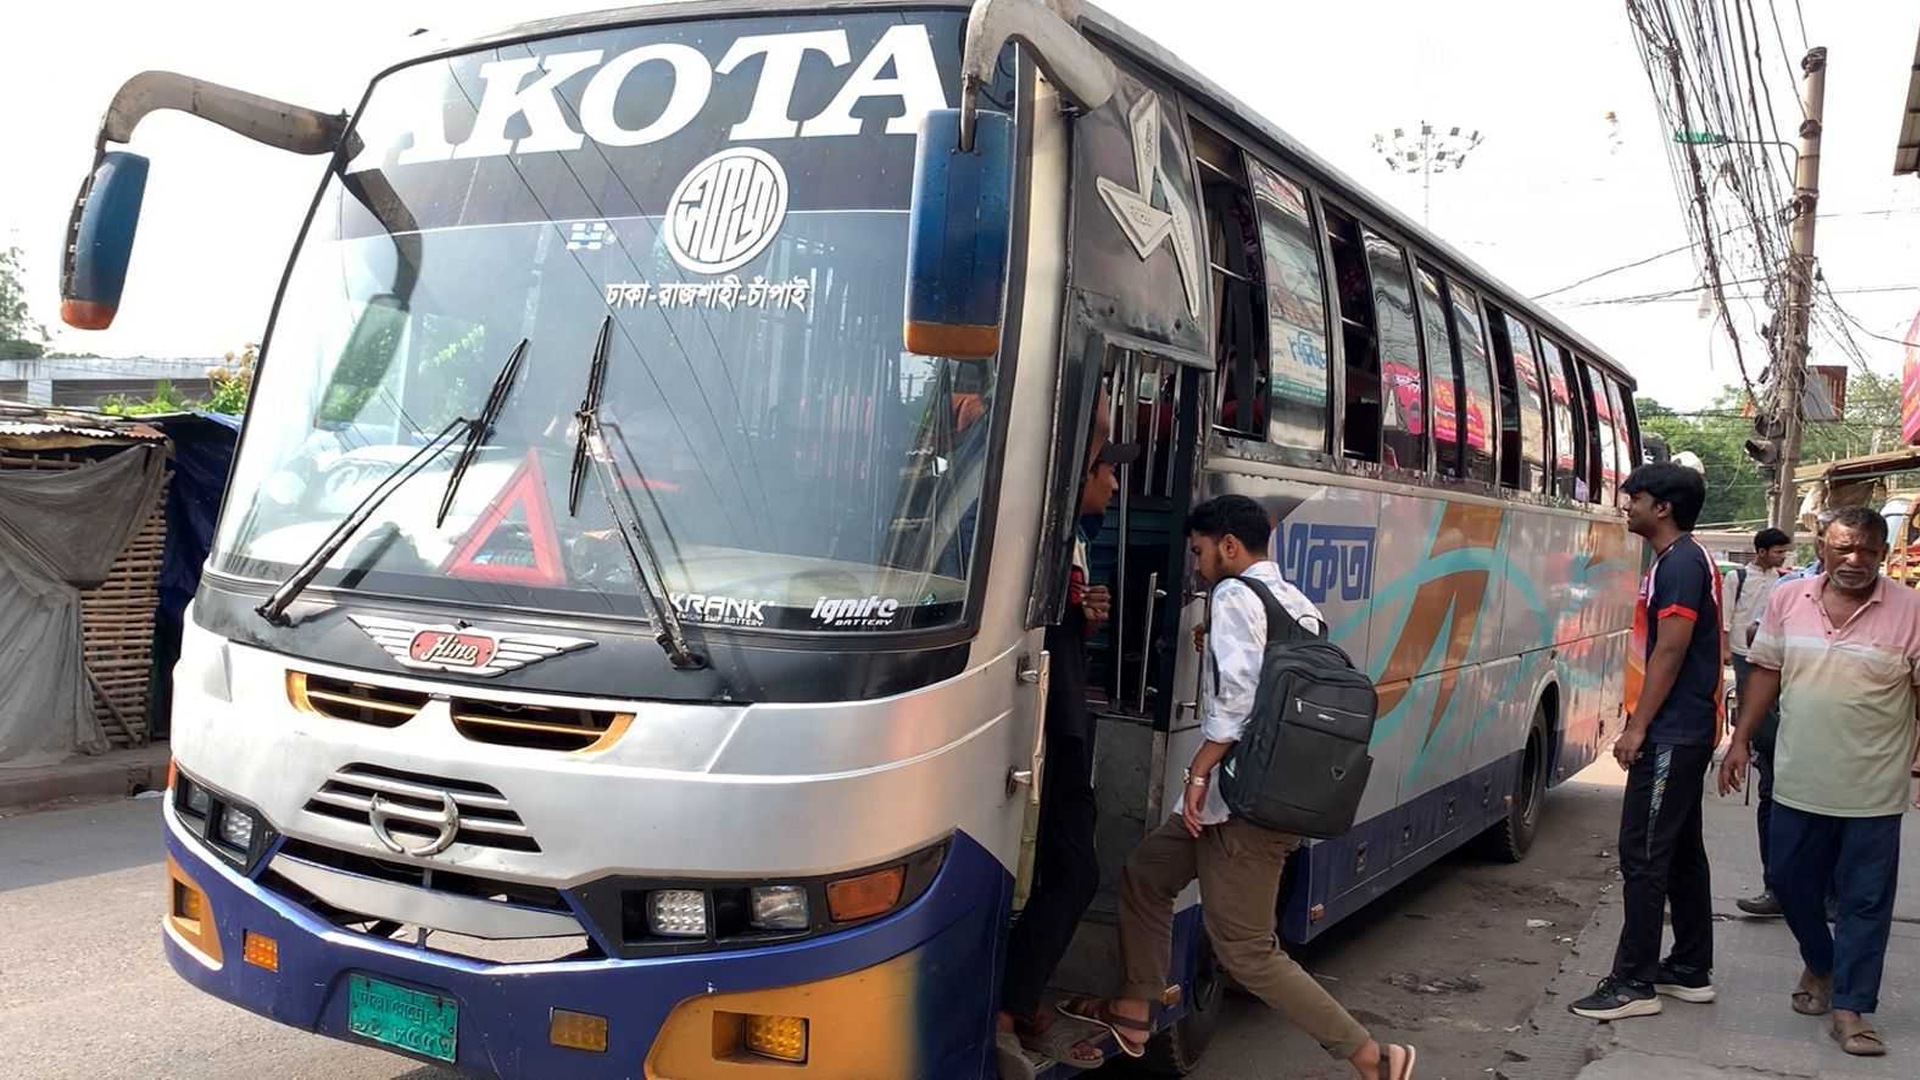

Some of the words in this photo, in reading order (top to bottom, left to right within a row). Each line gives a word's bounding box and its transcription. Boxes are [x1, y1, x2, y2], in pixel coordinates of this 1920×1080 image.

[606, 276, 811, 315] ঢাকা-রাজশাহী-চাঁপাই
[1276, 521, 1377, 604] একতা
[834, 618, 894, 627] BATTERY
